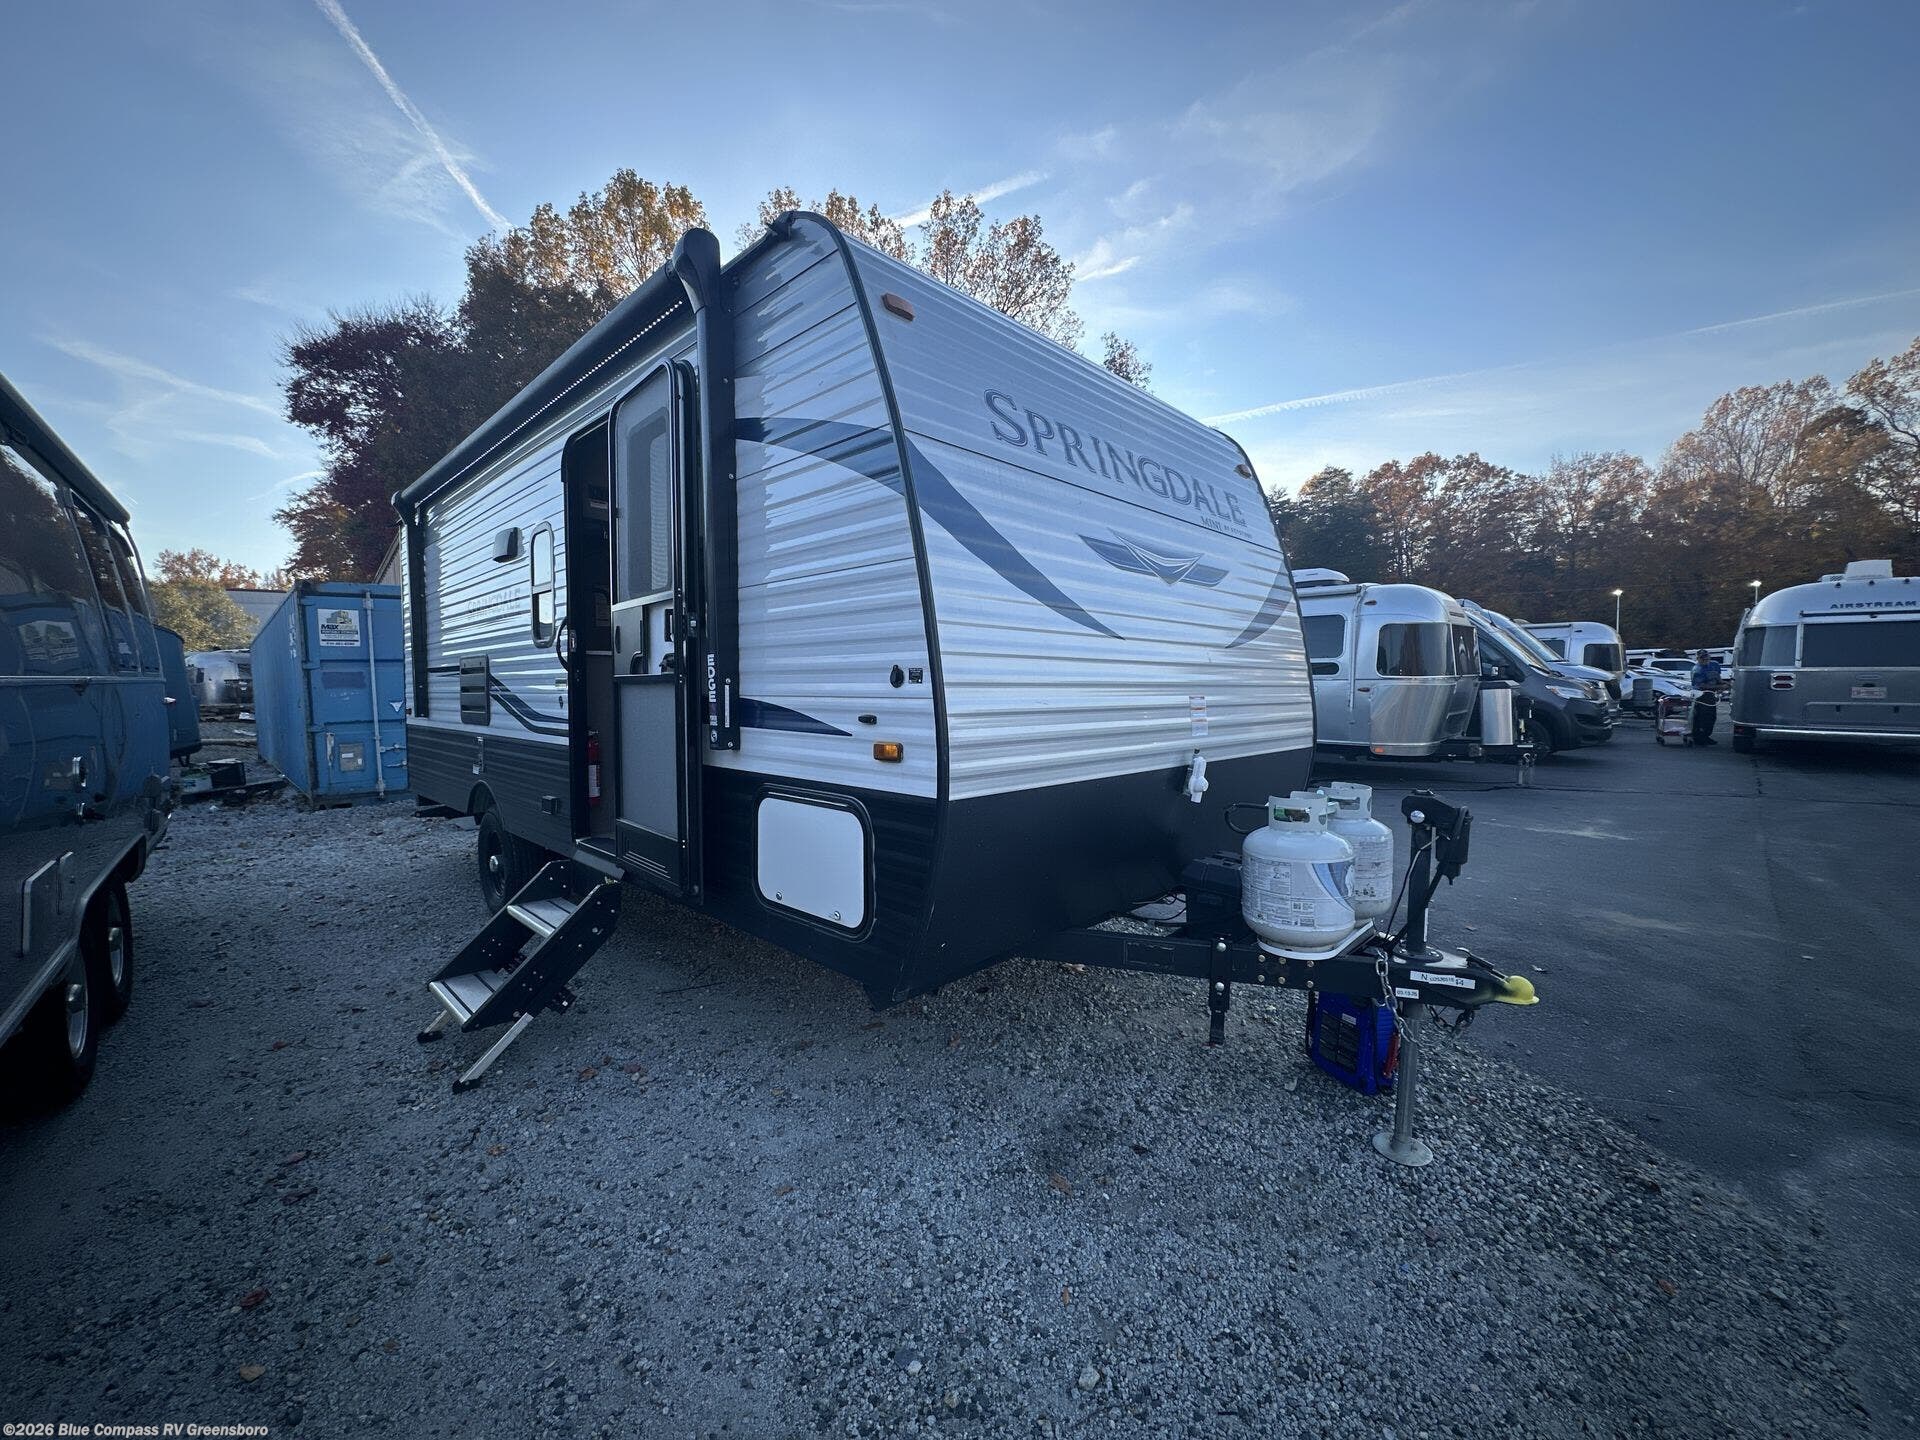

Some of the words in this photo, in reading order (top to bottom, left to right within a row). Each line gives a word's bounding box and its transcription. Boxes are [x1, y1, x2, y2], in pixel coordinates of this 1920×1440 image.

[984, 388, 1248, 528] SPRINGDALE
[1830, 601, 1917, 609] AIRSTREAM
[707, 653, 717, 703] EDGE
